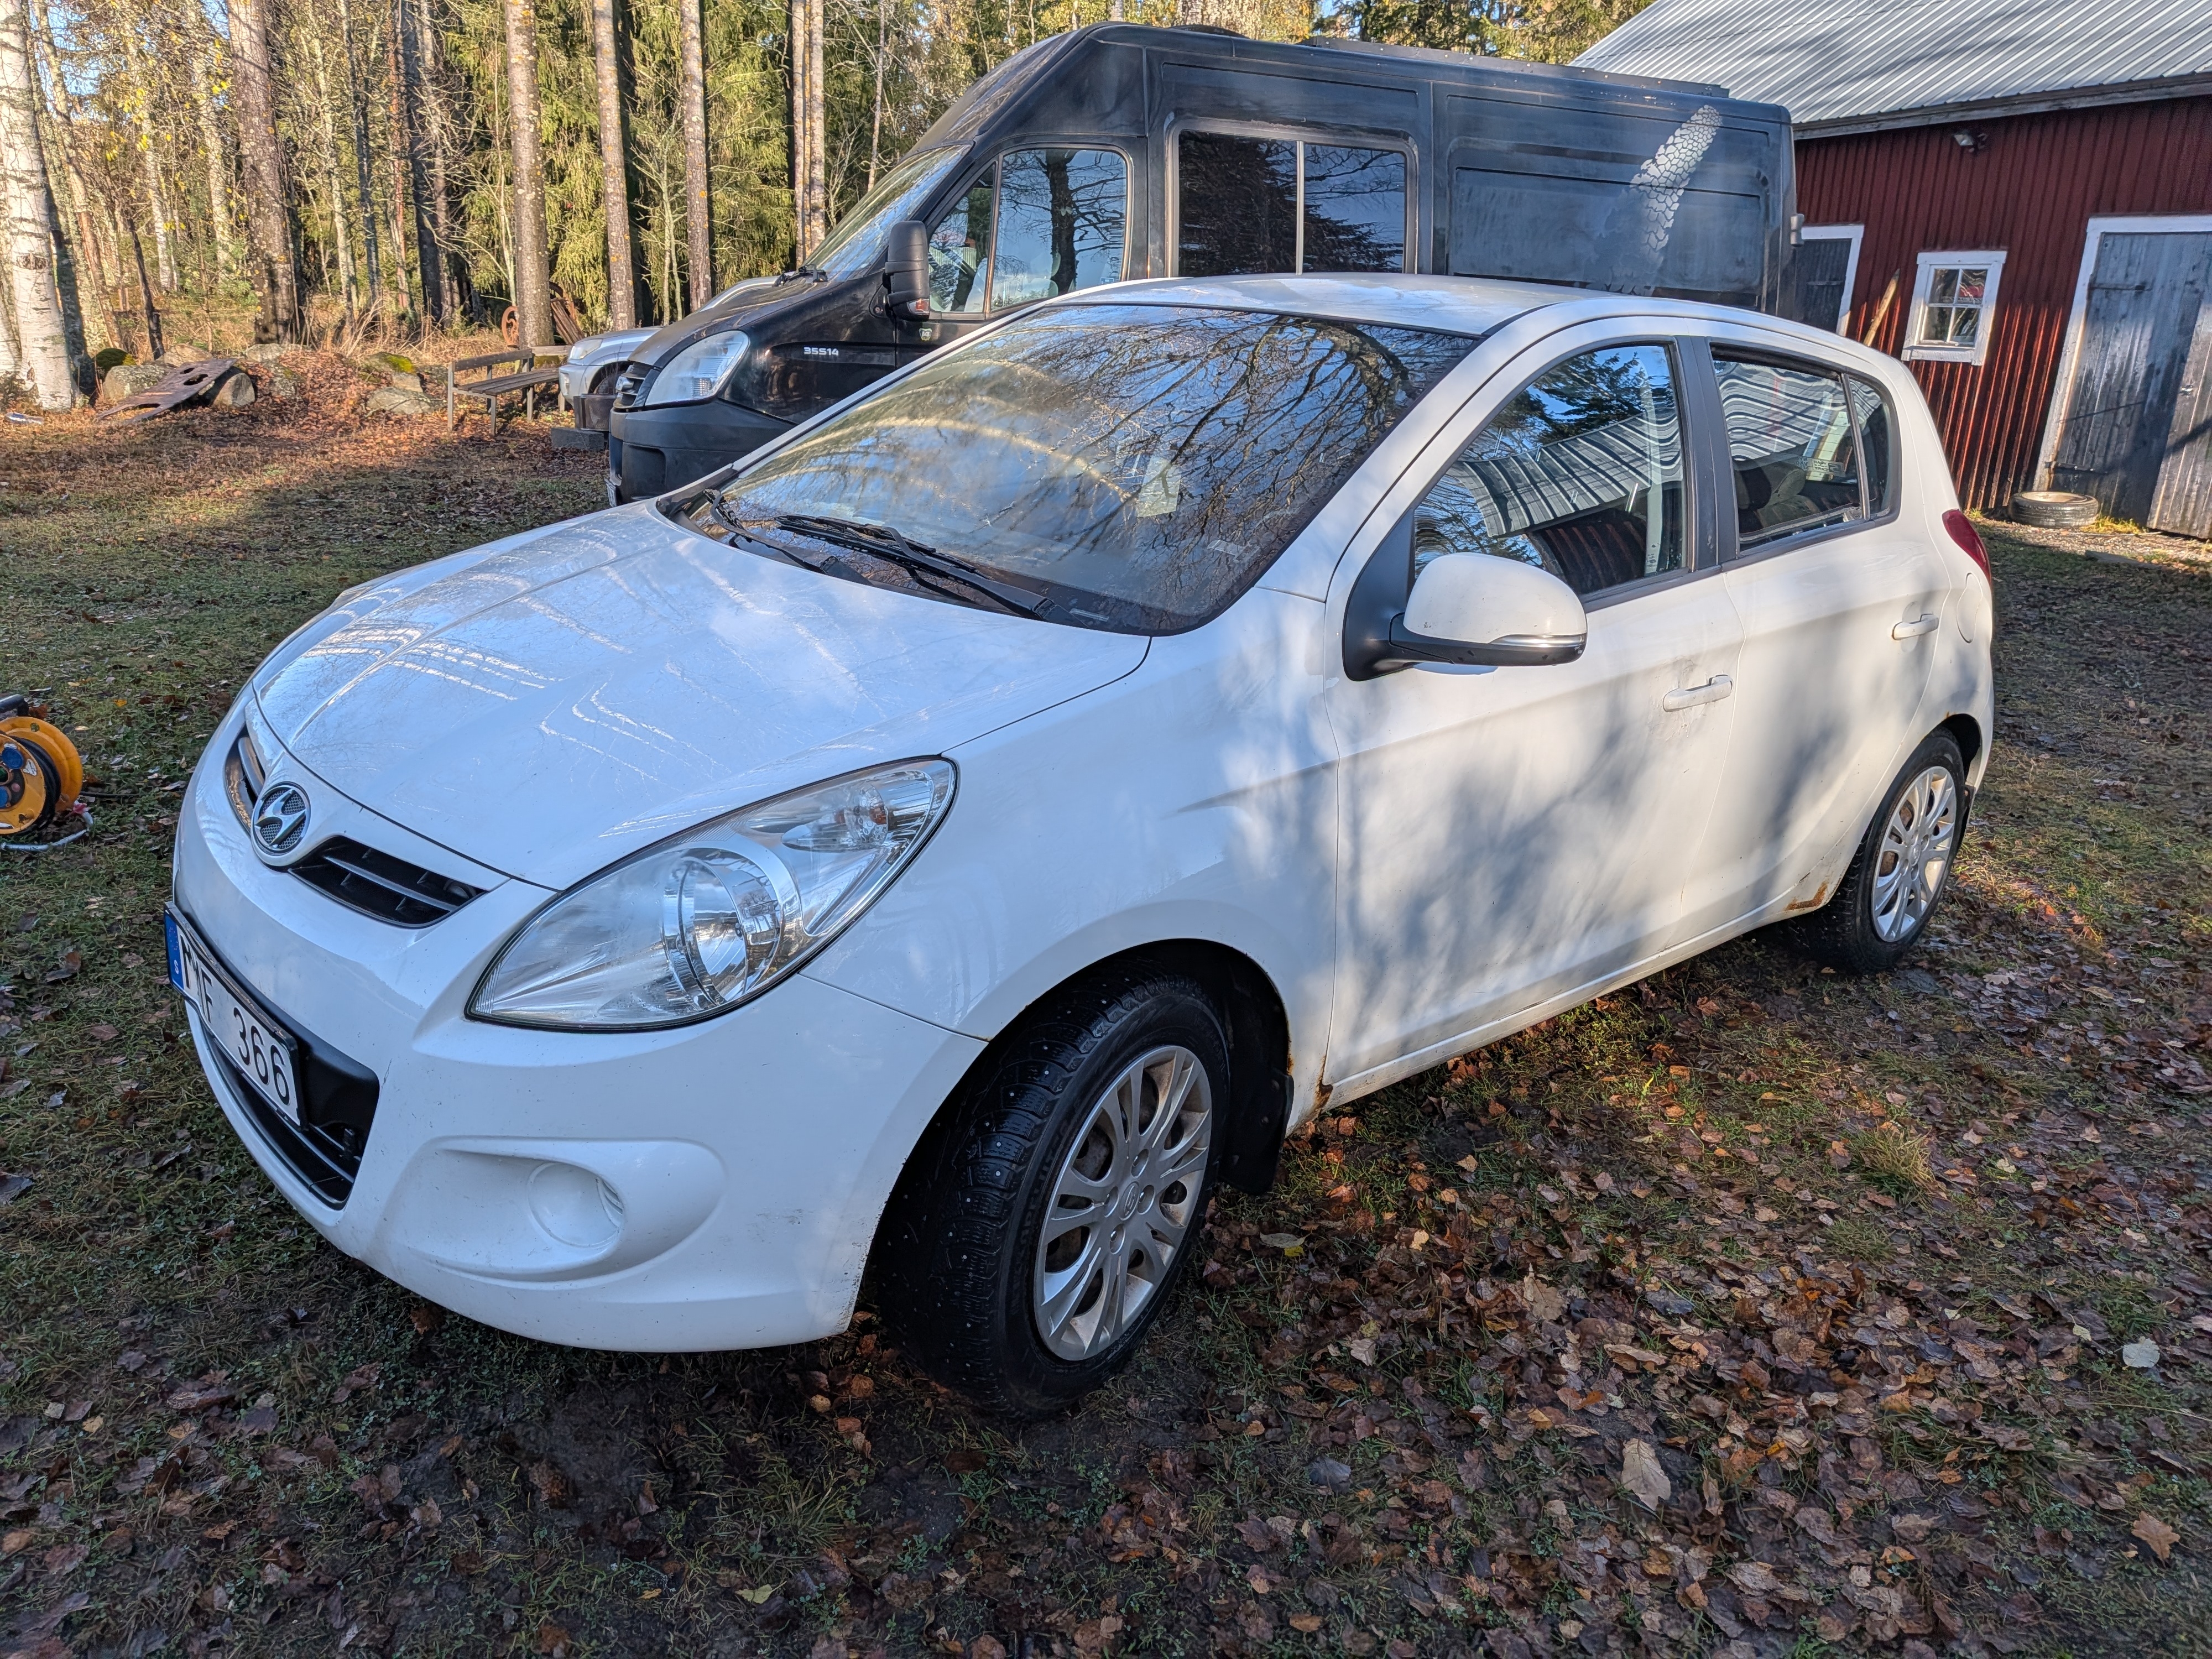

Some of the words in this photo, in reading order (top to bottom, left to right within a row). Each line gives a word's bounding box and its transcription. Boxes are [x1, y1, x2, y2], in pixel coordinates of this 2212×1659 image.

[804, 347, 839, 357] 35S14
[173, 959, 180, 974] S
[233, 1007, 290, 1105] 366
